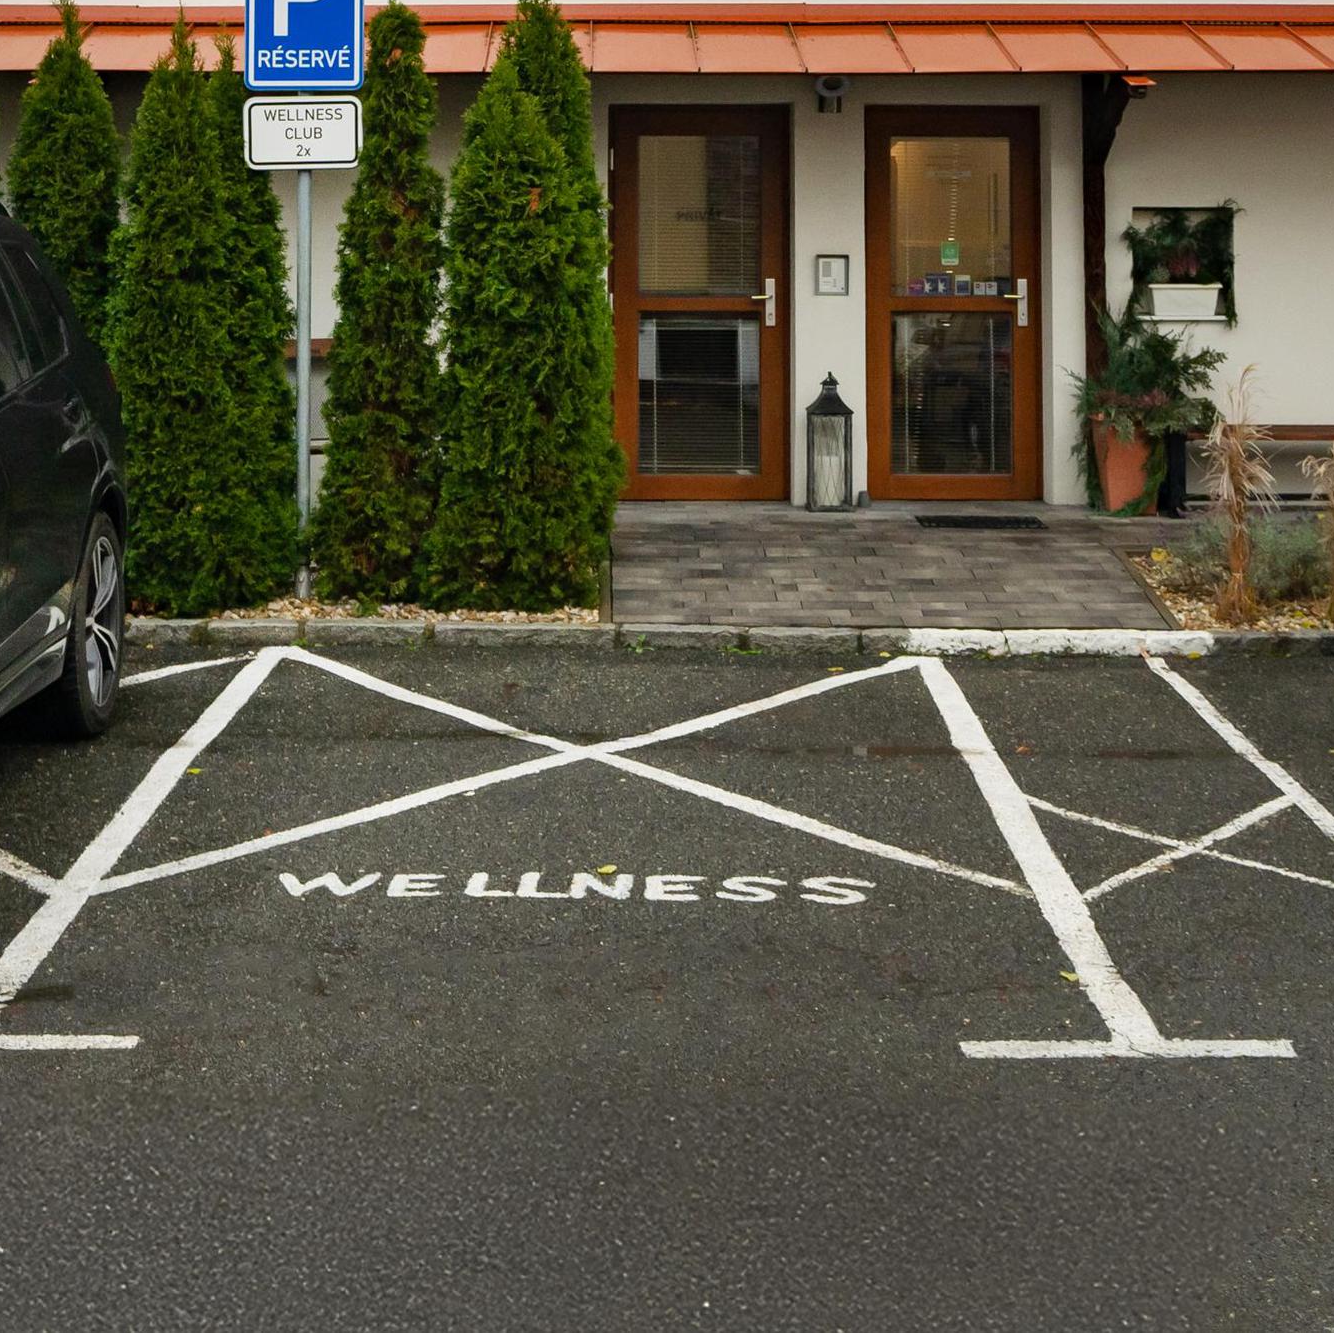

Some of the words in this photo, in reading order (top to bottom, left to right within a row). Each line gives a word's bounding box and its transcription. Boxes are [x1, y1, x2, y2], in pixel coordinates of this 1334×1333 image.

[258, 45, 351, 68] RÉSERVÉ
[263, 108, 343, 122] WELLNESS
[285, 127, 323, 140] CLUB
[296, 144, 312, 157] 2x
[278, 871, 876, 905] WELLNESS
